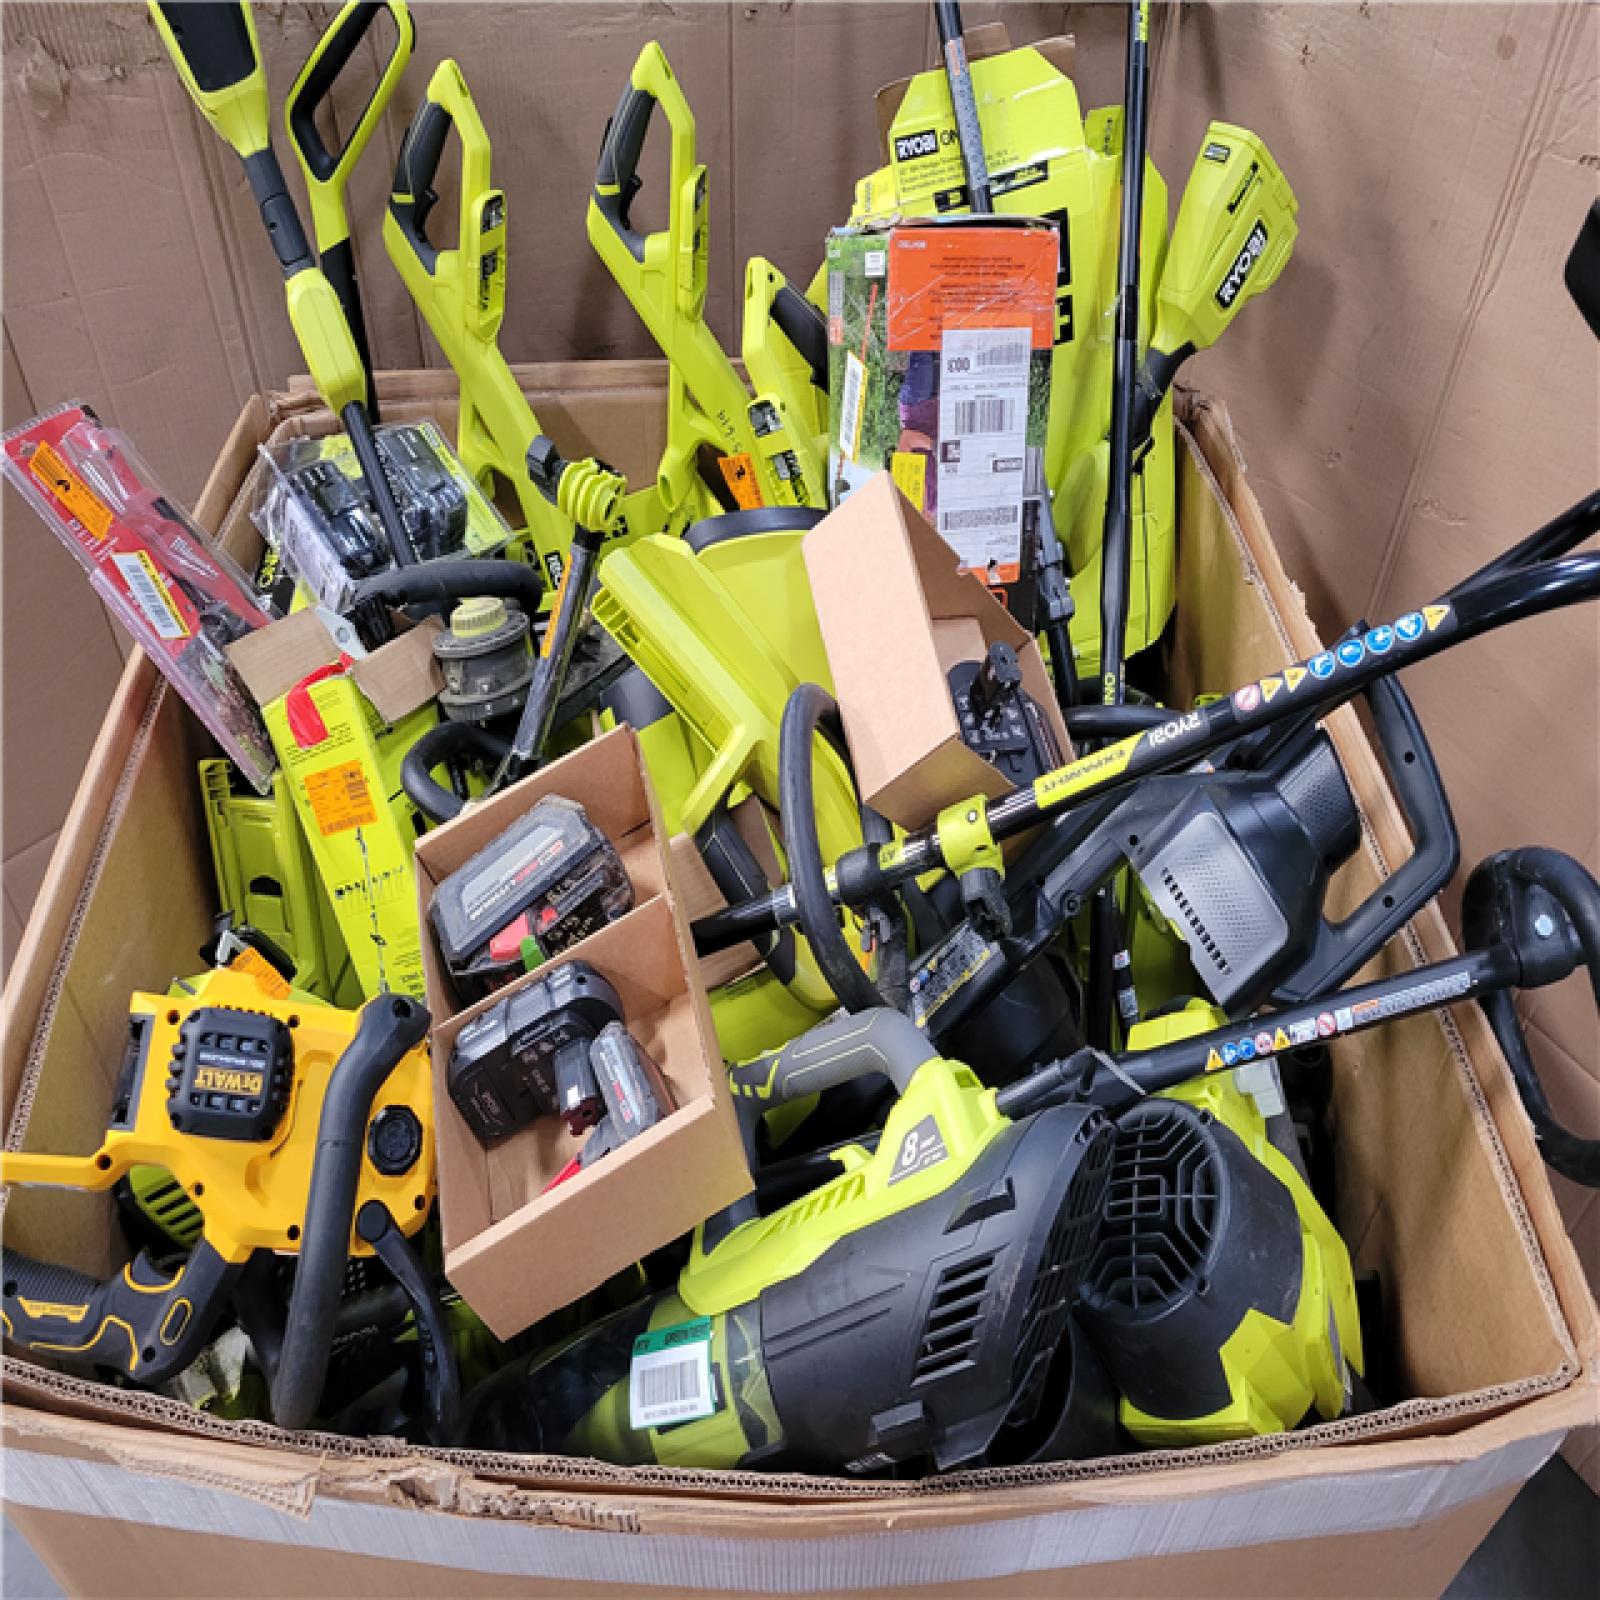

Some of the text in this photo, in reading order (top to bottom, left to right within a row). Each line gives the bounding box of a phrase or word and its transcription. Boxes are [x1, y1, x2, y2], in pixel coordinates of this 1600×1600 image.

[896, 133, 937, 161] RYOBI
[1217, 225, 1267, 304] RYOBI
[1149, 711, 1202, 748] RYOBI
[902, 1131, 919, 1166] 8
